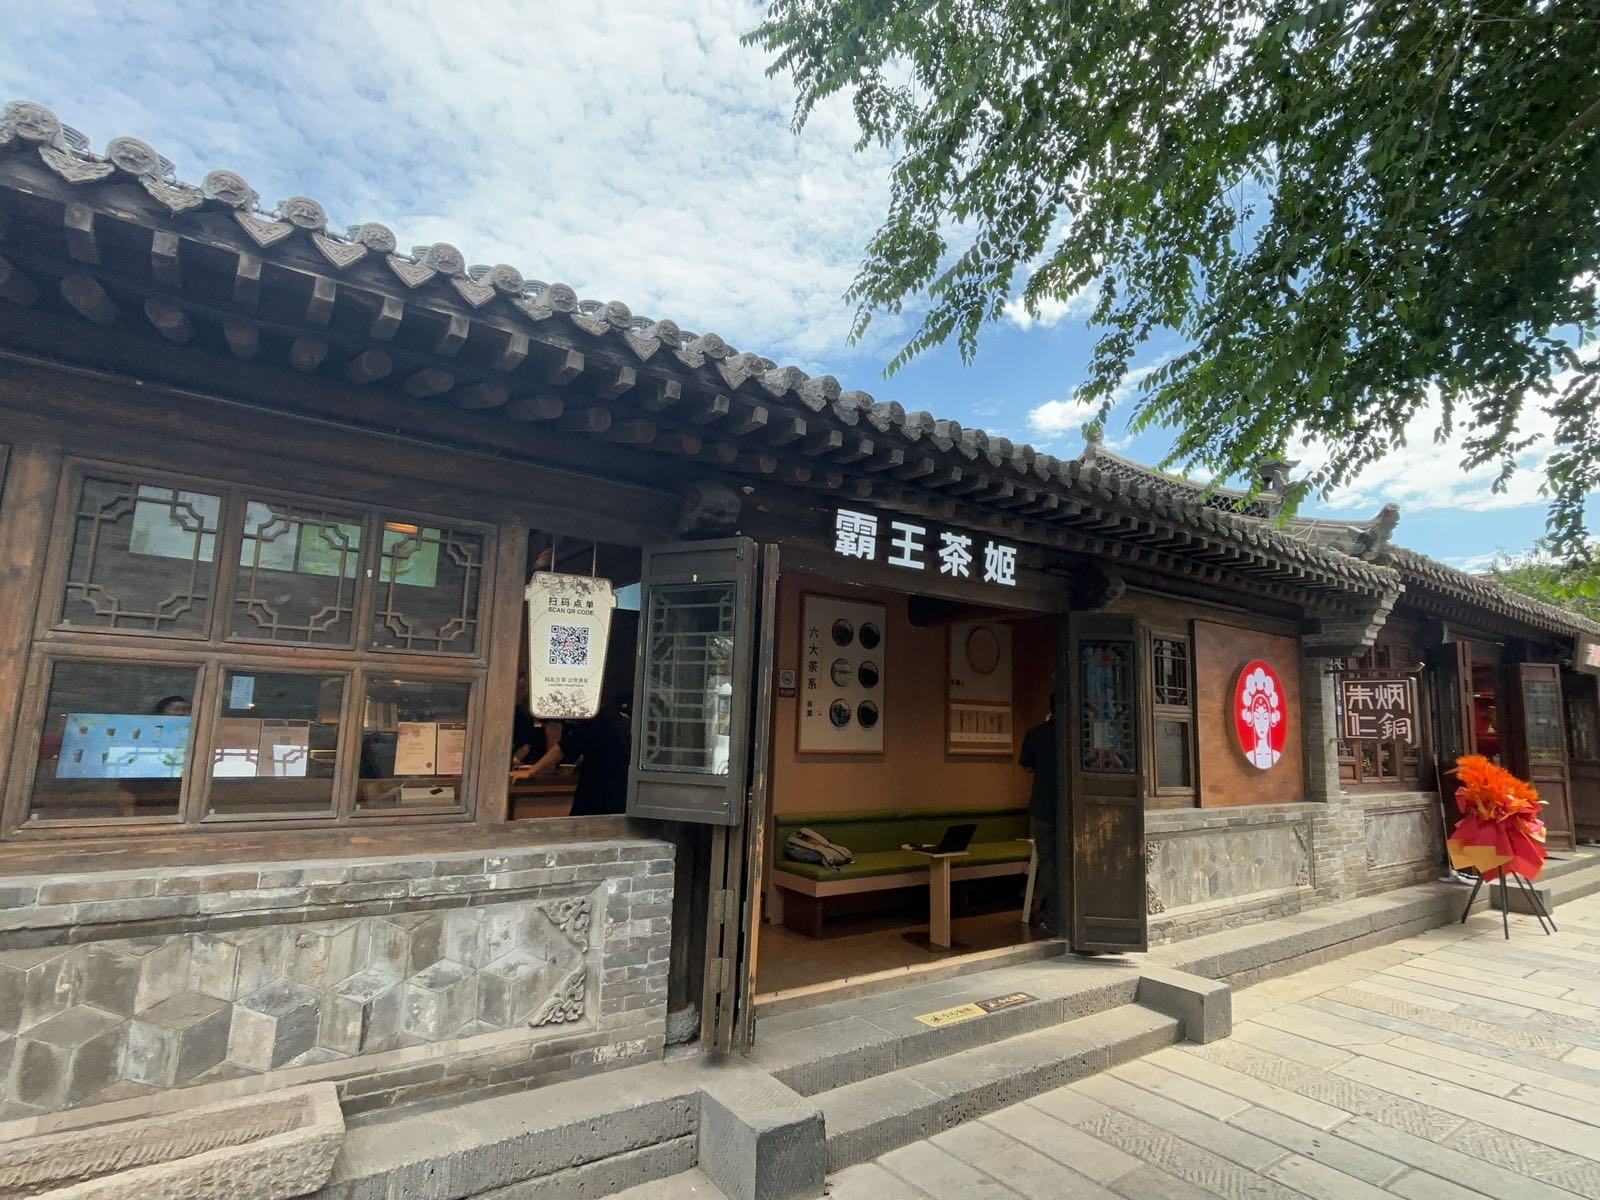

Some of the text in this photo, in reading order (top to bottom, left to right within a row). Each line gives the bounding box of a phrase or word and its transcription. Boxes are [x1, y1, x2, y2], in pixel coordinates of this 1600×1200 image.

[834, 508, 1018, 587] 霸王茶姬
[548, 597, 594, 609] 扫码点单
[807, 626, 819, 690] 六大茶系
